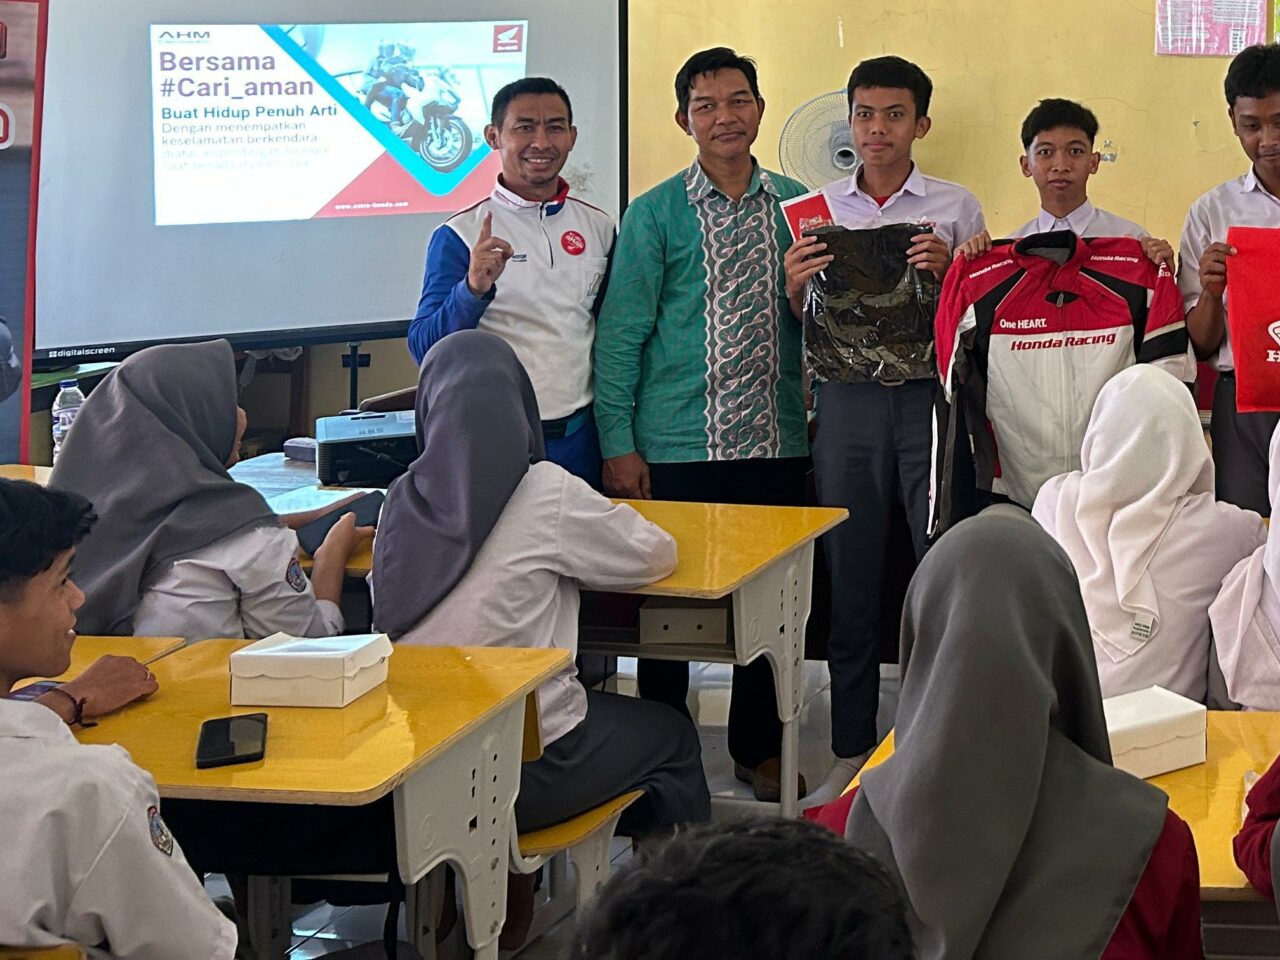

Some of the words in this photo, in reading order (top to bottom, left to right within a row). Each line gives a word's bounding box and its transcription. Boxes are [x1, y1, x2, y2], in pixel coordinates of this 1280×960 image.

[159, 31, 210, 39] AHM
[159, 51, 275, 71] Bersama
[160, 77, 314, 100] #Cari_aman
[162, 107, 198, 120] Buat
[204, 106, 250, 121] Hidup
[255, 105, 304, 117] Penuh
[310, 104, 338, 116] Arti
[162, 123, 212, 135] Dengan
[216, 121, 306, 133] menempatkan
[162, 135, 244, 146] keselamatan
[247, 134, 318, 144] berkendara
[969, 266, 992, 279] Honda
[991, 259, 1013, 270] Racing
[1000, 319, 1017, 328] One
[1011, 337, 1063, 350] Honda
[1063, 333, 1116, 347] Racing
[57, 347, 115, 357] digitalscreen
